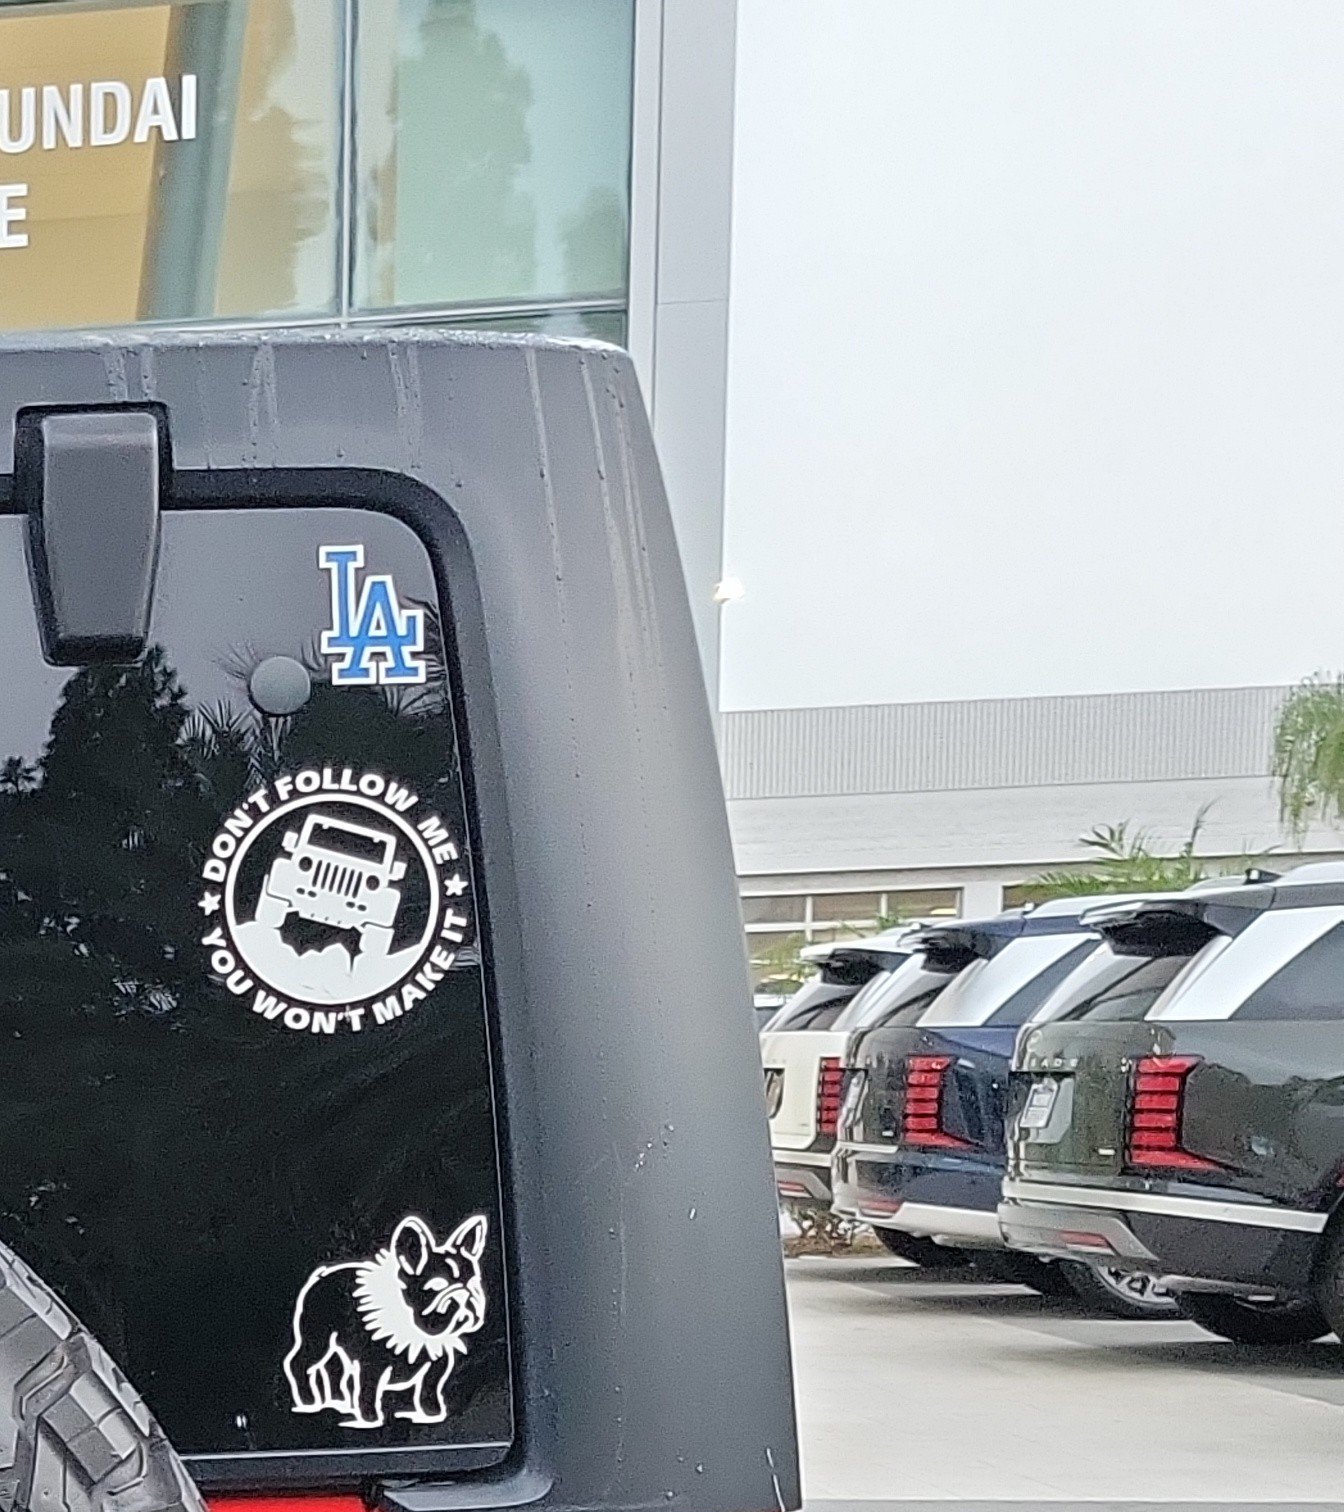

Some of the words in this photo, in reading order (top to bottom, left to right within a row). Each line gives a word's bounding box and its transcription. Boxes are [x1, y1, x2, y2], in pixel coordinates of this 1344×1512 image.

[318, 544, 427, 685] LA
[202, 788, 271, 883] DON'T
[274, 768, 419, 813] FOLLOW
[416, 815, 459, 865] ME
[201, 927, 254, 995] YOU
[252, 990, 366, 1034] WON'T
[372, 945, 456, 1025] MAKE
[440, 908, 468, 943] IT
